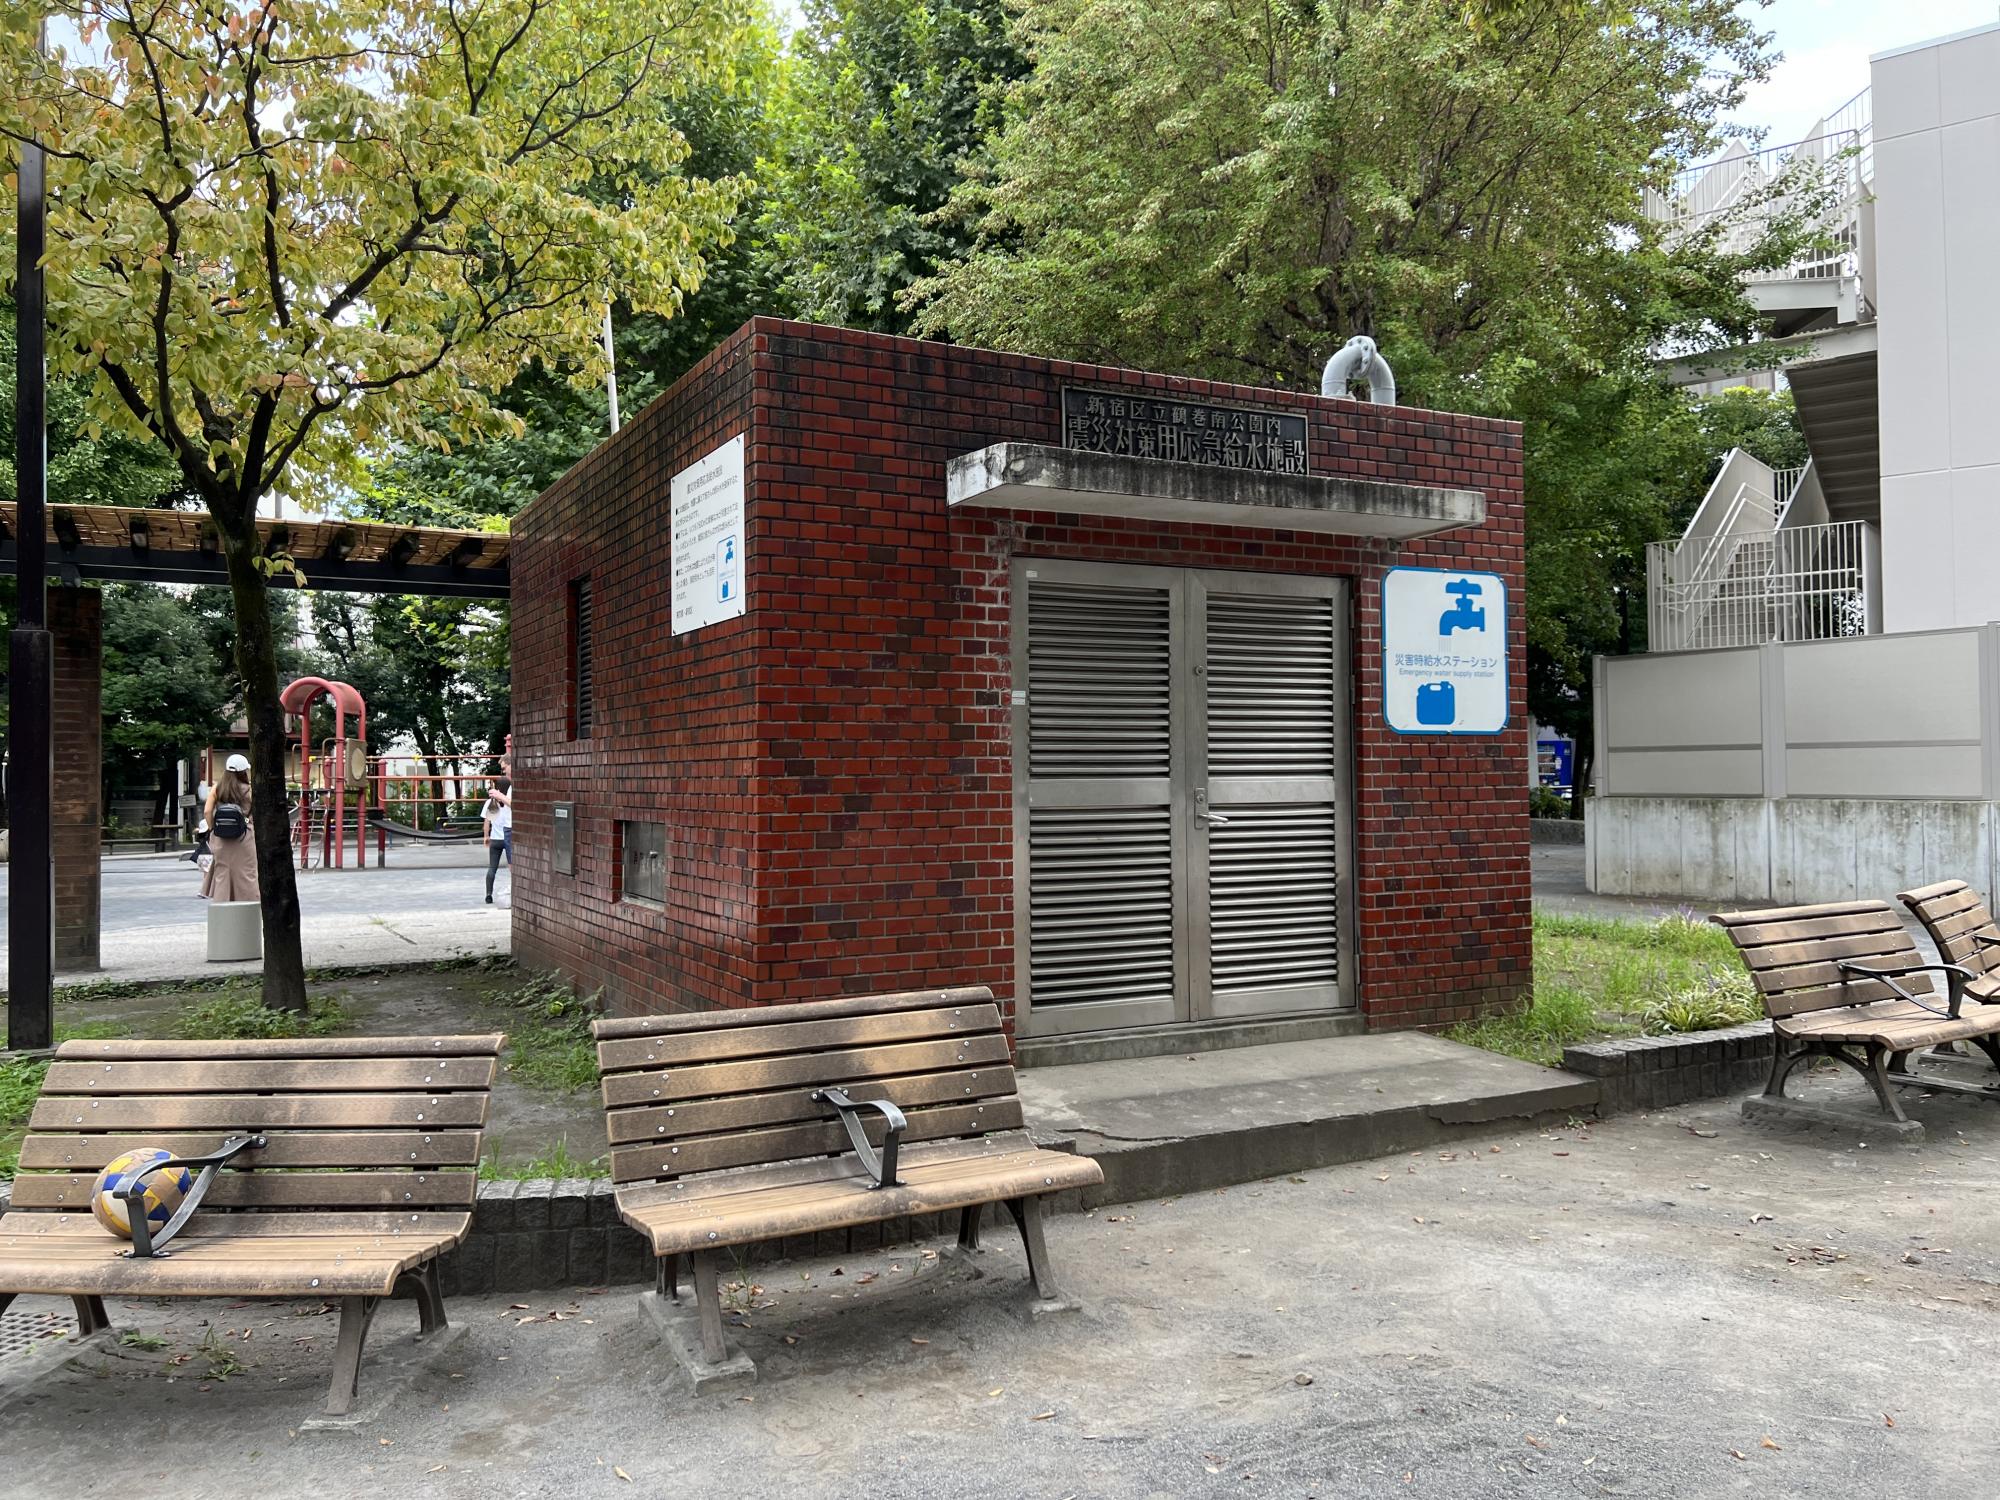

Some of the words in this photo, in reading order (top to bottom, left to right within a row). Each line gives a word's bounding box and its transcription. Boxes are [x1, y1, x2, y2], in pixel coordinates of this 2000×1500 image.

[1087, 395, 1281, 435] 新宿区立鶴巻南公園内
[1068, 413, 1305, 473] 震災対策用応急給水施設
[1395, 653, 1497, 668] 災害時給水ステーション
[1399, 668, 1432, 677] Emergency
[1453, 670, 1472, 678] supply
